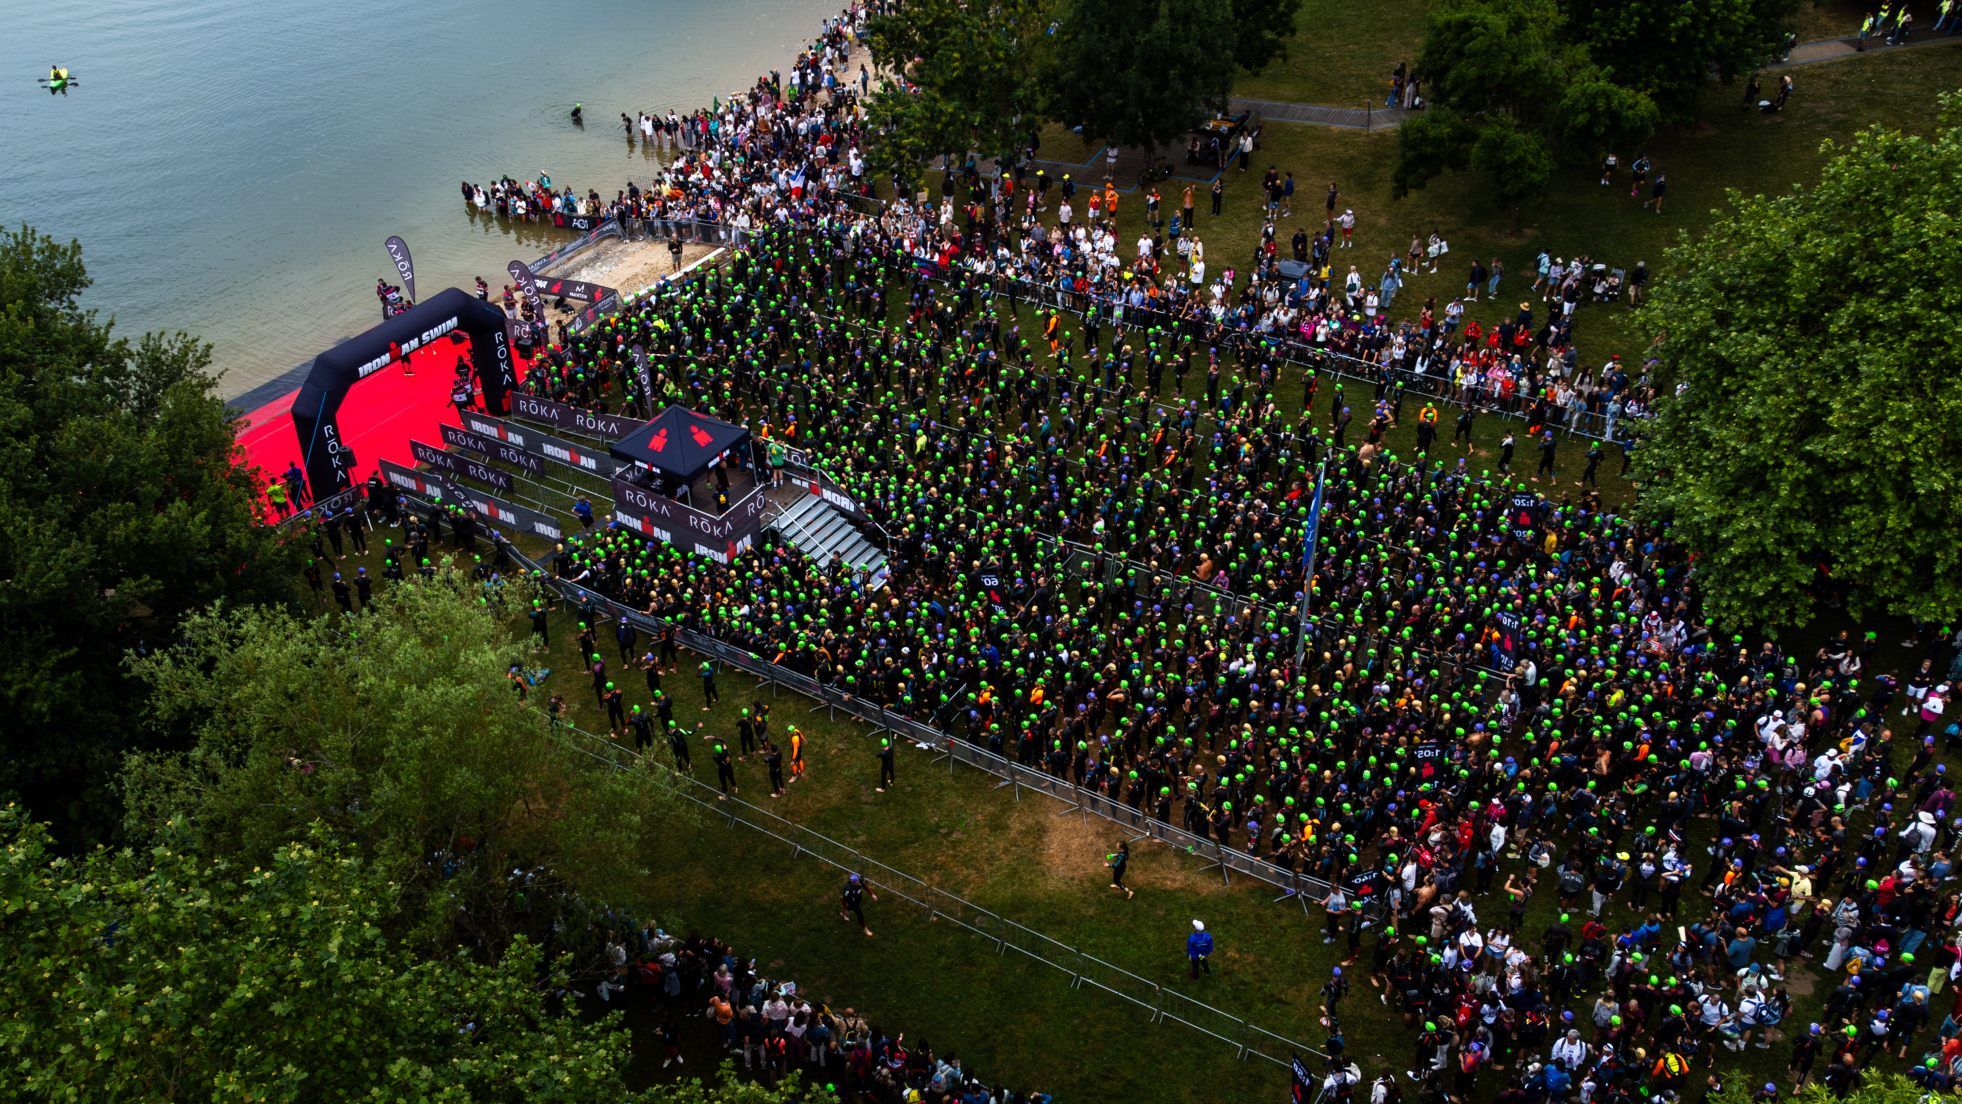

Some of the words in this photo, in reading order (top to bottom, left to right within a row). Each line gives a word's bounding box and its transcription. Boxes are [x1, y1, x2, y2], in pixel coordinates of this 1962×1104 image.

[358, 337, 420, 379] IRONMAN
[421, 316, 458, 345] SWIM
[471, 419, 525, 447] IRONMAN
[542, 442, 597, 470] IRONMAN
[389, 471, 442, 498] IRONMAN
